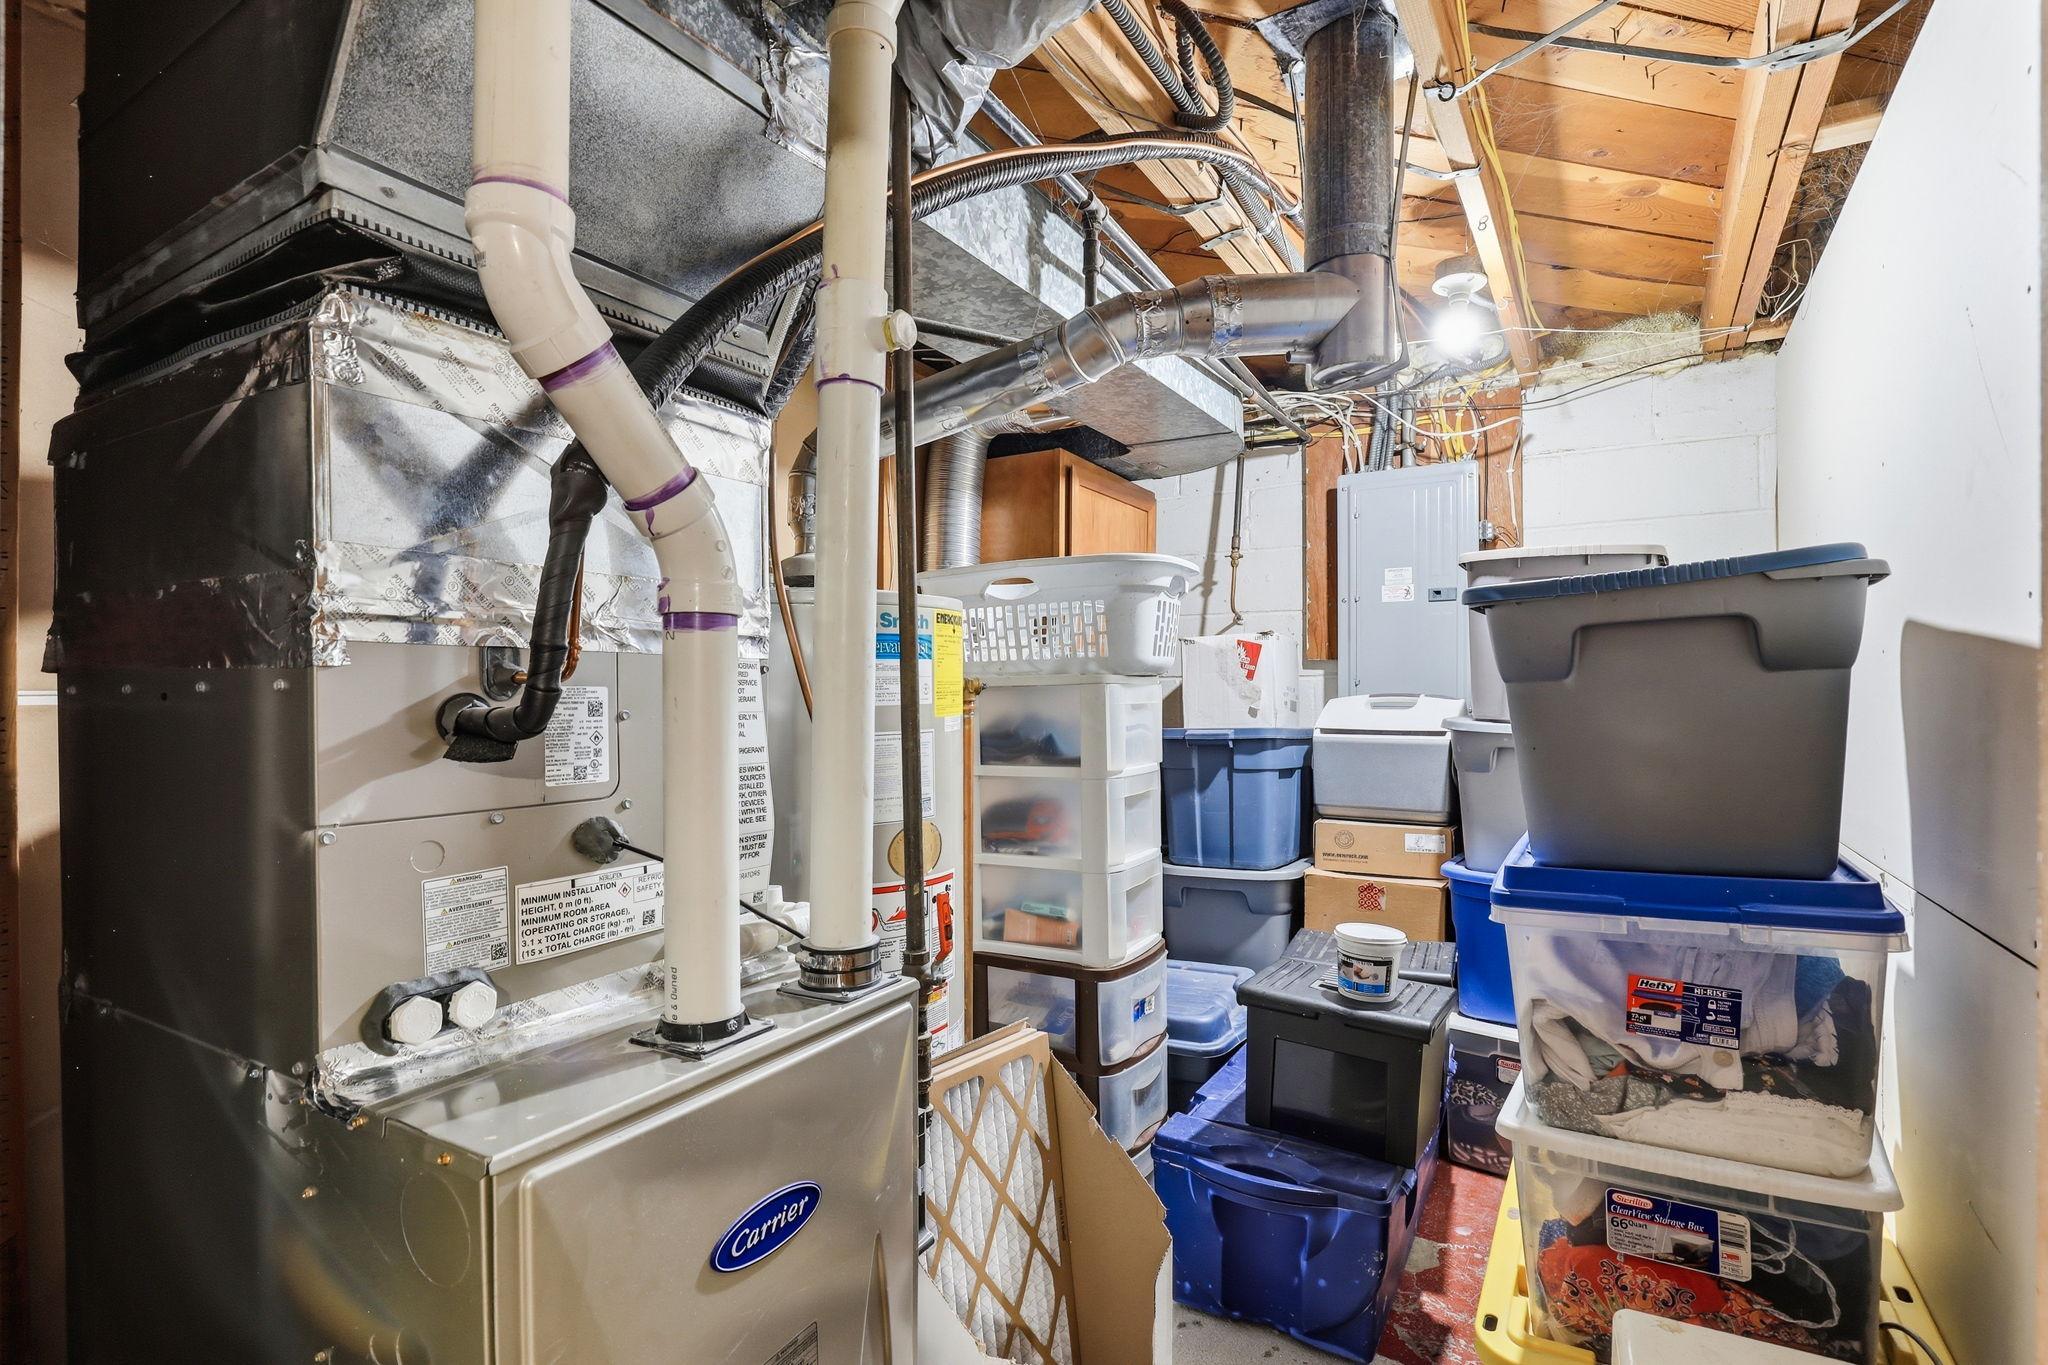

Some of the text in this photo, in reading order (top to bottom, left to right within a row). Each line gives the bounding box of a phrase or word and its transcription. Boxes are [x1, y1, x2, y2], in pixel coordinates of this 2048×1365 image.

[443, 346, 469, 374] POLYKEN
[739, 773, 766, 782] SOURCES
[521, 881, 617, 906] MINIMUM INSTALLATION
[636, 882, 660, 893] SAFETY
[521, 902, 610, 926] MINIMUM ROOM AREA
[558, 902, 564, 910] 0
[574, 898, 582, 909] (0
[521, 921, 574, 937] (OPERATING
[576, 915, 588, 925] OR
[521, 938, 535, 948] 3.1
[545, 931, 570, 943] TOTAL
[573, 923, 606, 936] CHARGE
[607, 919, 621, 931] (kg)
[521, 948, 536, 960] (15
[546, 941, 572, 953] TOTAL
[573, 932, 606, 946] CHARGE
[607, 929, 619, 940] (lb)
[1640, 979, 1674, 992] Hefty
[731, 1195, 809, 1258] Carrier
[1610, 1204, 1705, 1233] ClearView Storage Box
[1610, 1216, 1648, 1230] 66 Quart
